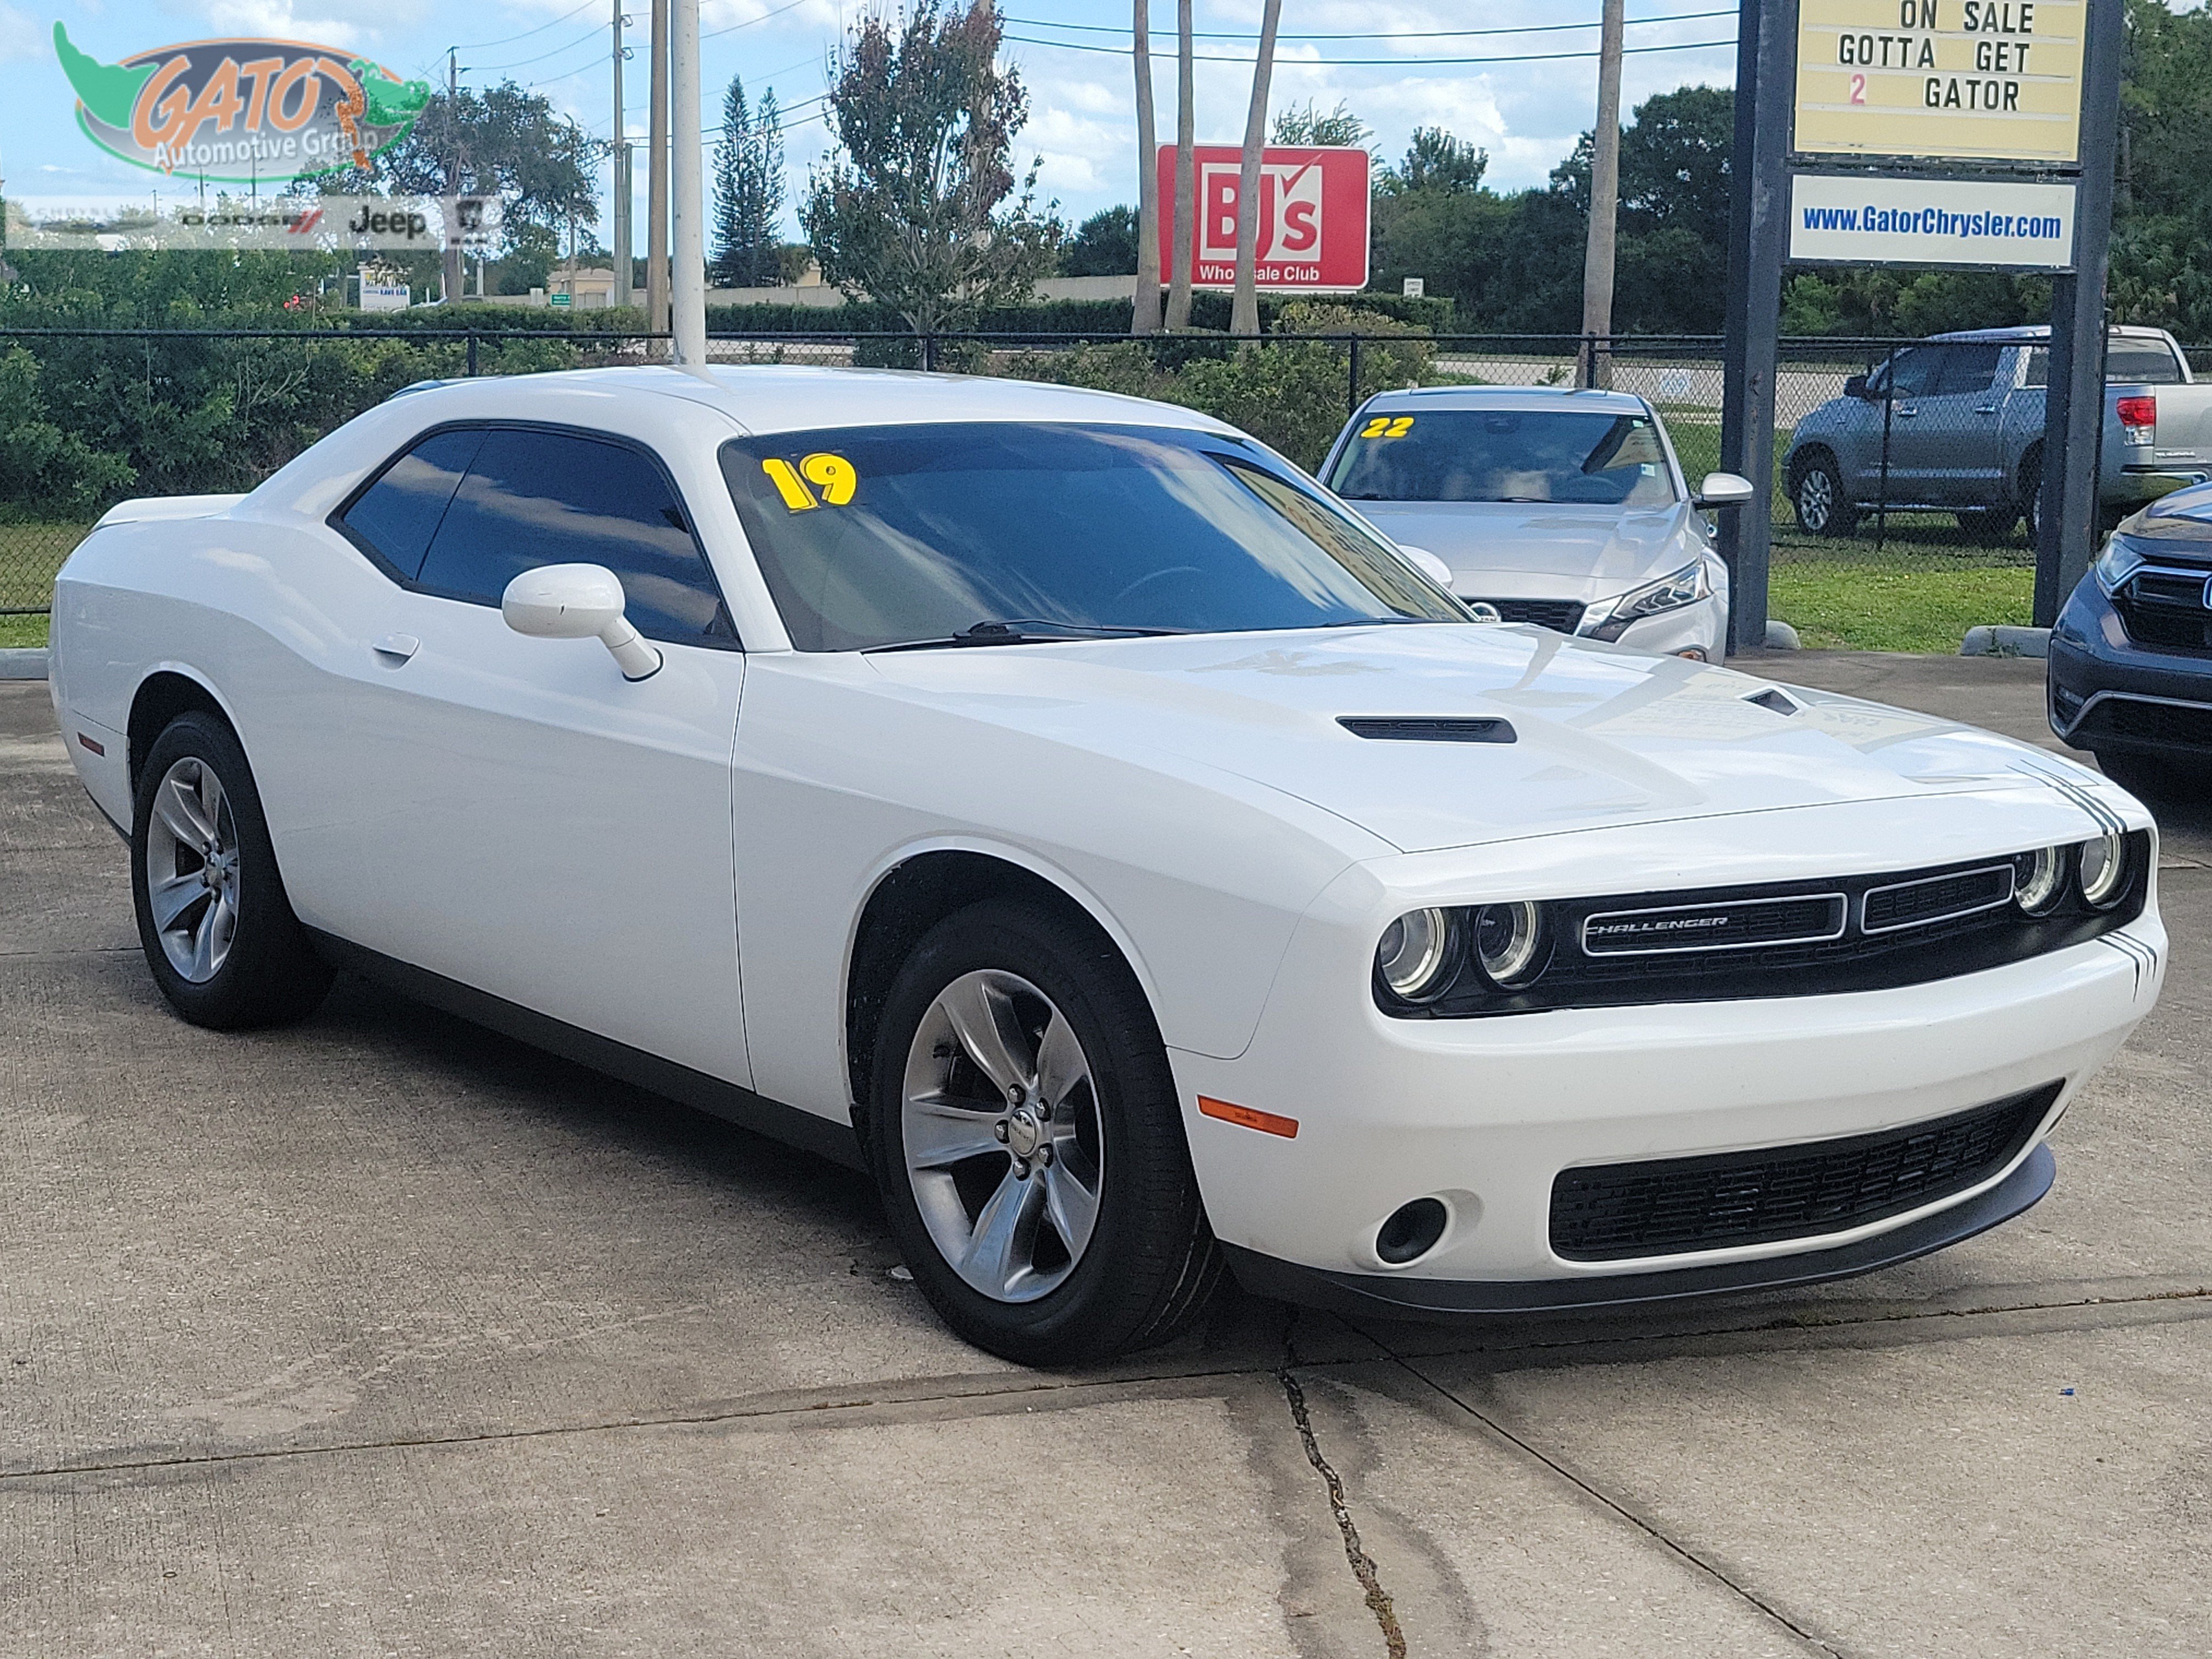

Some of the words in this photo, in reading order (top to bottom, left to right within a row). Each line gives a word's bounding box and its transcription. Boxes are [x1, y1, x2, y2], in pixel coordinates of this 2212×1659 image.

[1900, 0, 1937, 28] ON
[1963, 1, 2033, 33] SALE
[1839, 34, 1934, 68] GOTTA
[1976, 41, 2029, 72] GET
[1850, 74, 1865, 105] 2
[1926, 78, 2018, 111] GATOR
[1803, 206, 2061, 238] www.GatorChrysler.com
[1284, 266, 1319, 281] Club
[1361, 417, 1414, 438] 22
[762, 453, 857, 510] 19
[1586, 917, 1728, 934] CHALLENGER
